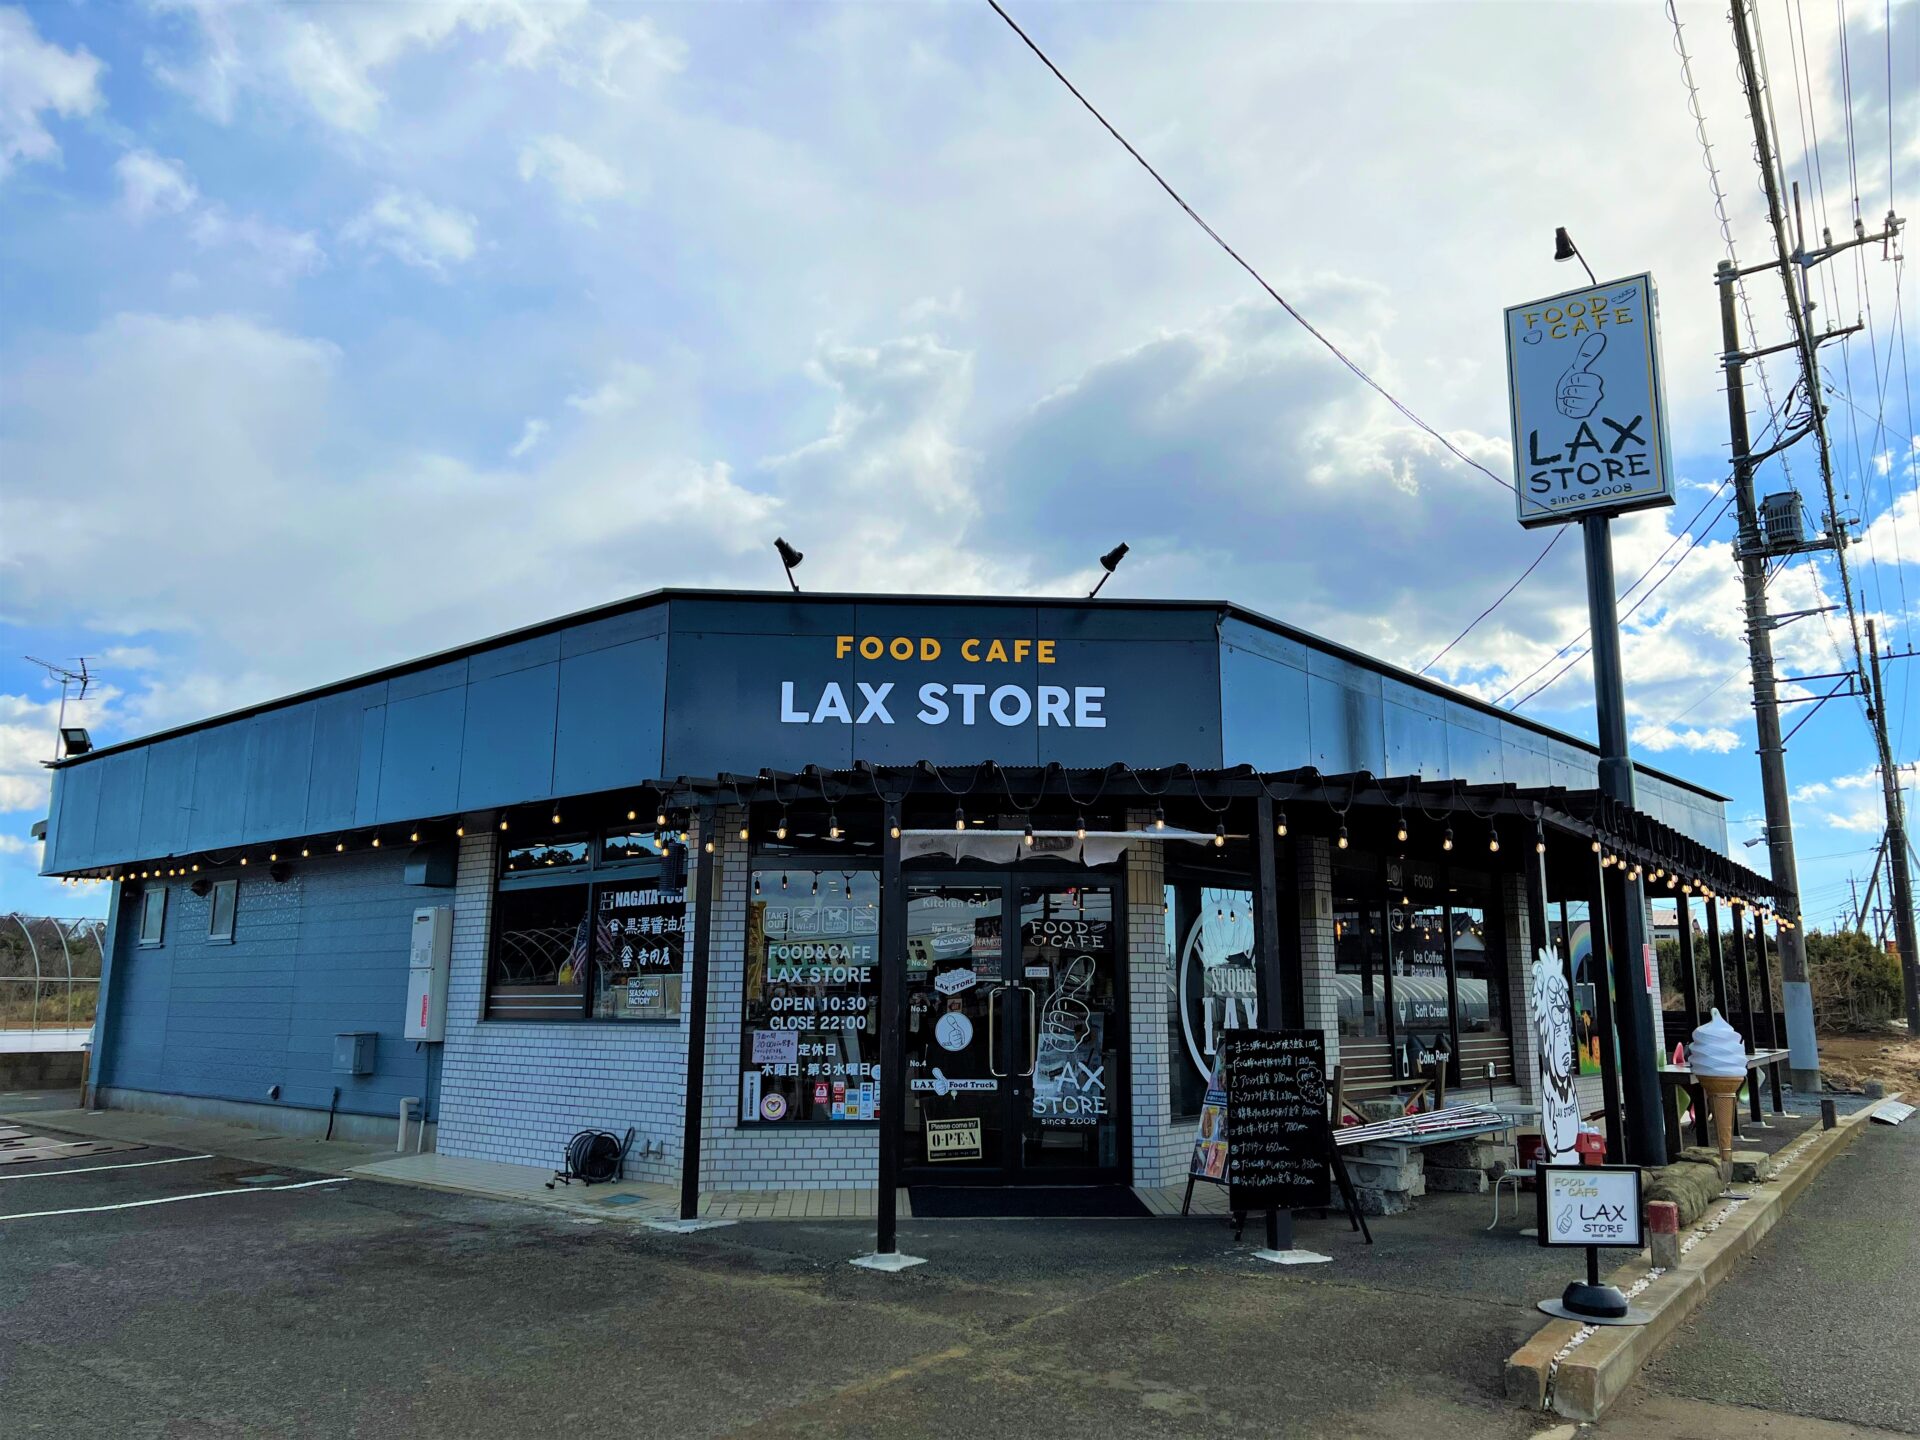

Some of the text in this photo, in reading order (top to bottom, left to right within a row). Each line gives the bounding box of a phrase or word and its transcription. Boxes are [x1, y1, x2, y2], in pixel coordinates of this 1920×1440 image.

[1523, 295, 1608, 329] FOOD
[1551, 308, 1633, 339] CAFE
[1529, 415, 1647, 466] LAX
[1530, 453, 1650, 493] STORE
[1550, 482, 1633, 505] since 2008
[835, 635, 1056, 664] FOOD CAFE
[780, 681, 1107, 728] LAX STORE
[1414, 874, 1434, 889] FOOD
[614, 889, 659, 908] NAGATA
[923, 897, 964, 908] Kitchen
[766, 911, 788, 920] TAKE
[767, 920, 785, 929] OUT
[1029, 920, 1089, 935] FOOD
[1050, 934, 1105, 949] CAFE
[768, 945, 871, 959] FOOD&CAFE
[1413, 949, 1444, 964] Ice Coffee
[911, 959, 928, 967] No.2
[1411, 964, 1433, 977] Banana
[766, 966, 872, 983] LAX STORE
[1211, 967, 1253, 993] STORE
[935, 977, 975, 992] LAX STORE
[628, 989, 659, 997] SEASONING
[628, 997, 651, 1005] FACTORY
[770, 996, 867, 1011] OPEN 10:30
[910, 1004, 928, 1013] No.3
[1415, 1003, 1449, 1018] Soft Cream
[769, 1015, 867, 1030] CLOSE 22:00
[798, 1043, 837, 1056] 定休日
[909, 1059, 927, 1067] No.4
[913, 1080, 995, 1089] LAX Food Truck
[1032, 1061, 1106, 1093] LAX
[1032, 1095, 1108, 1115] STORE
[1555, 1103, 1576, 1118] LAX STORE
[930, 1122, 951, 1130] Please
[1041, 1116, 1097, 1126] since 2008
[1553, 1177, 1586, 1187] FOOD
[1567, 1187, 1599, 1198] CAFE
[1579, 1203, 1628, 1222] LAX
[1582, 1223, 1624, 1233] STORE
